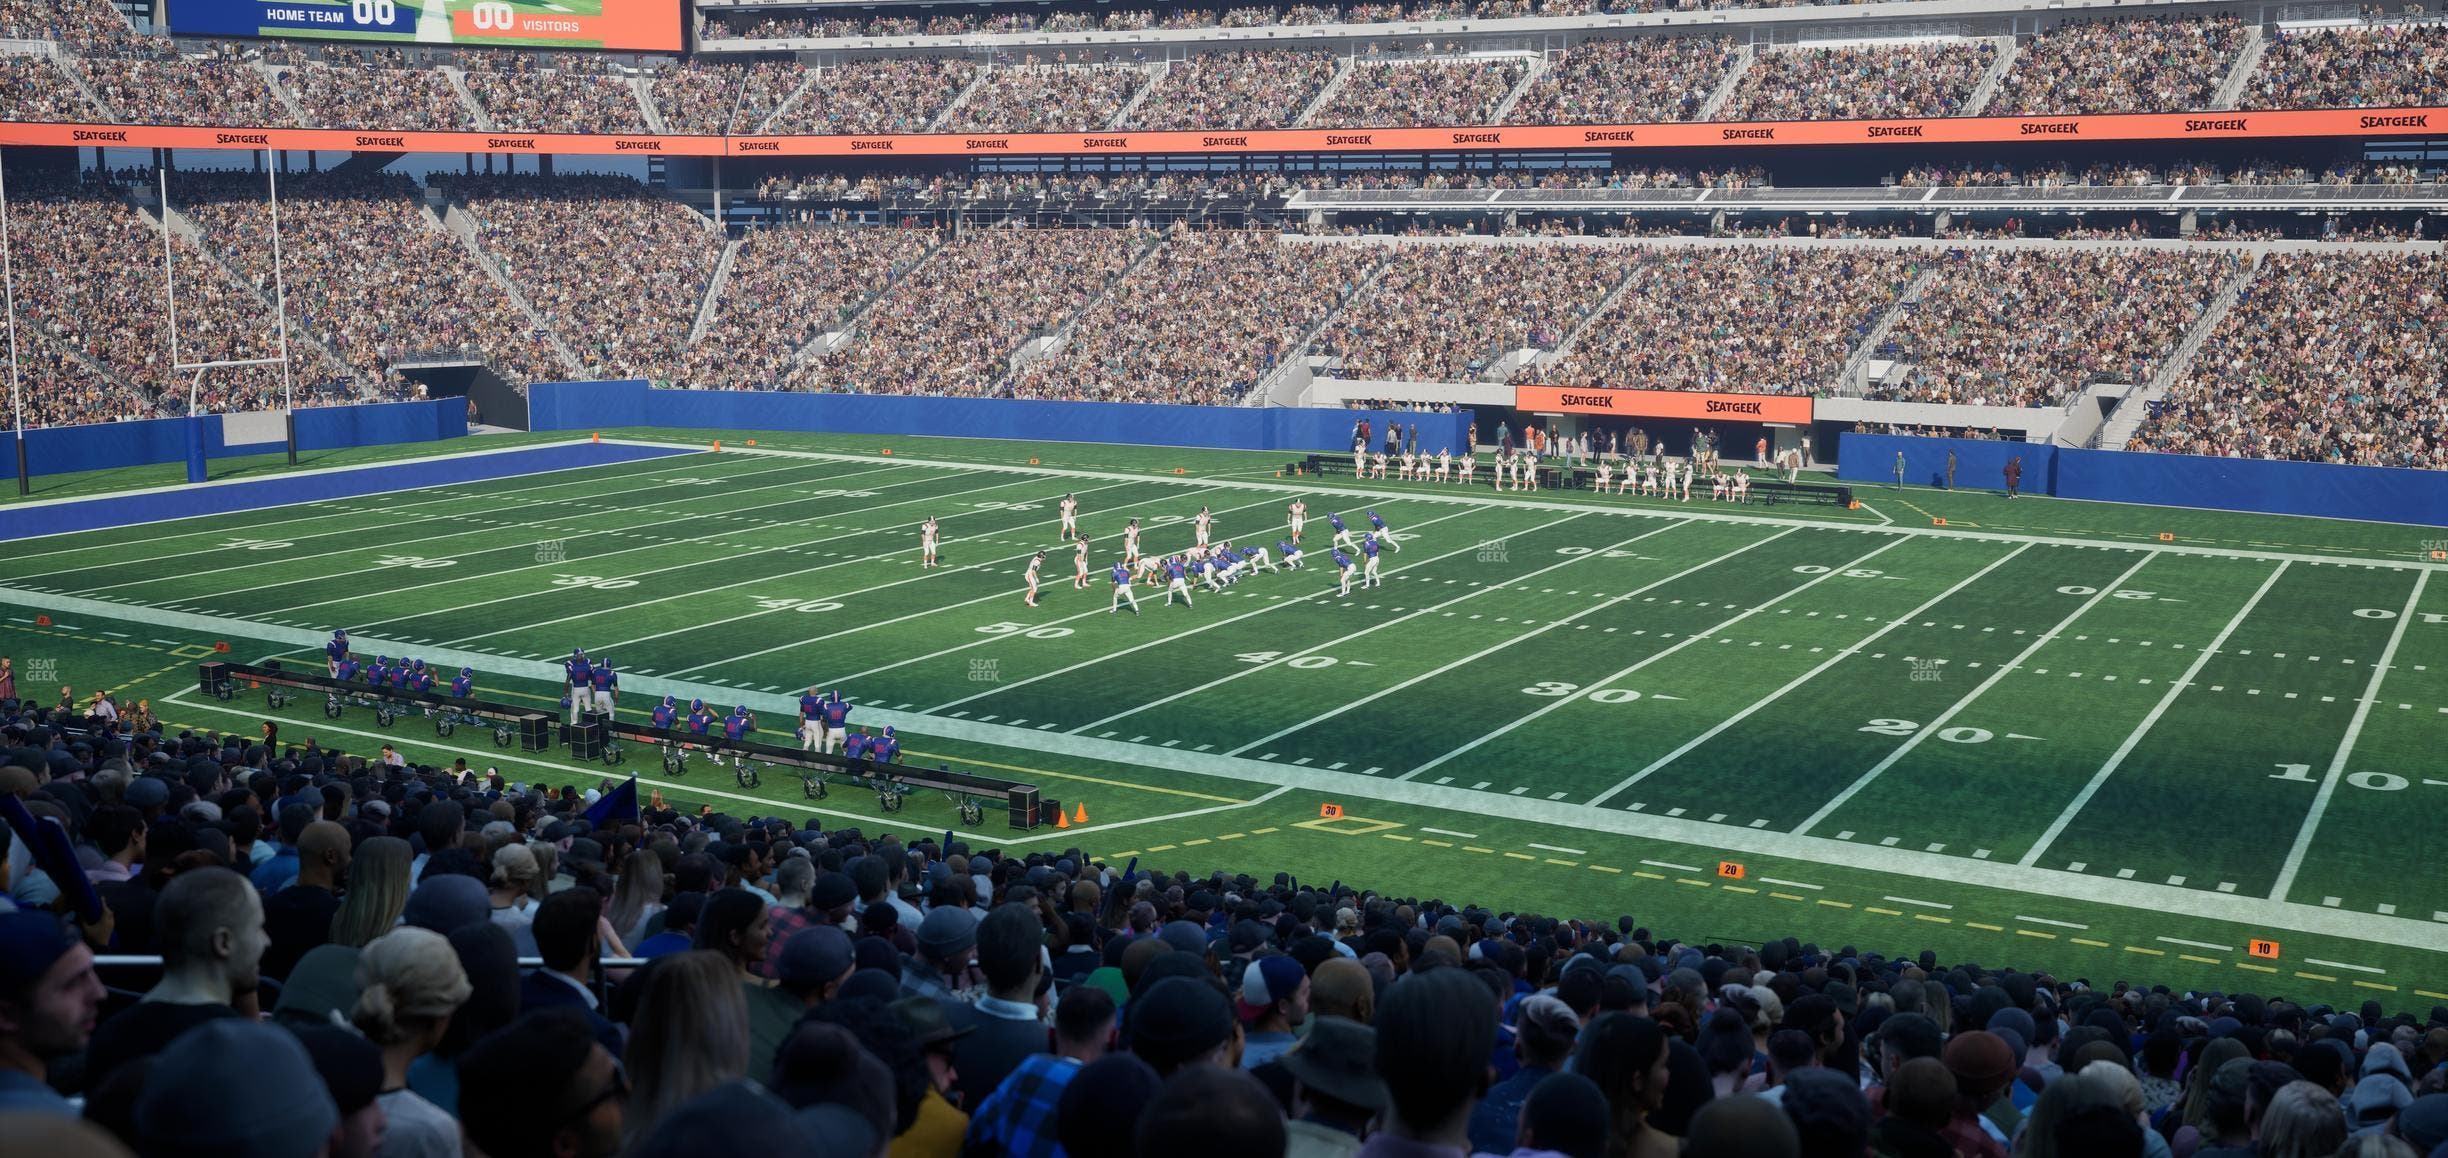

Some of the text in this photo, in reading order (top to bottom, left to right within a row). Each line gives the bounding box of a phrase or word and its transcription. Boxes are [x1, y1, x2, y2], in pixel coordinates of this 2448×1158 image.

[267, 9, 345, 23] HOME TEAM
[352, 0, 396, 25] 00
[473, 2, 514, 30] 00
[523, 20, 579, 33] VISITORS
[2185, 119, 2247, 131] SEATGEEK
[2360, 115, 2427, 128] SEATGEEK
[1723, 129, 1773, 139] SEATGEEK
[1868, 126, 1922, 137] SEATGEEK
[2021, 123, 2078, 134] SEATGEEK
[73, 131, 127, 141] SEATGEEK
[217, 134, 268, 144] SEATGEEK
[1203, 137, 1247, 146] SEATGEEK
[1327, 135, 1371, 145] SEATGEEK
[1453, 133, 1500, 143] SEATGEEK
[1585, 131, 1633, 141] SEATGEEK
[356, 137, 404, 147] SEATGEEK
[488, 139, 534, 148] SEATGEEK
[616, 141, 660, 150] SEATGEEK
[740, 142, 779, 151] SEATGEEK
[852, 141, 892, 150] SEATGEEK
[967, 140, 1008, 149] SEATGEEK
[1084, 138, 1126, 148] SEATGEEK
[1561, 394, 1614, 409] SEATGEEK
[1707, 401, 1762, 415] SEATGEEK
[974, 622, 1075, 638] 50
[1233, 651, 1339, 669] 40
[1520, 682, 1642, 703] 30
[1857, 718, 1994, 744] 20
[2267, 763, 2410, 793] 10
[1326, 805, 1337, 816] 30
[1725, 864, 1737, 876] 20
[2257, 943, 2271, 955] 10
